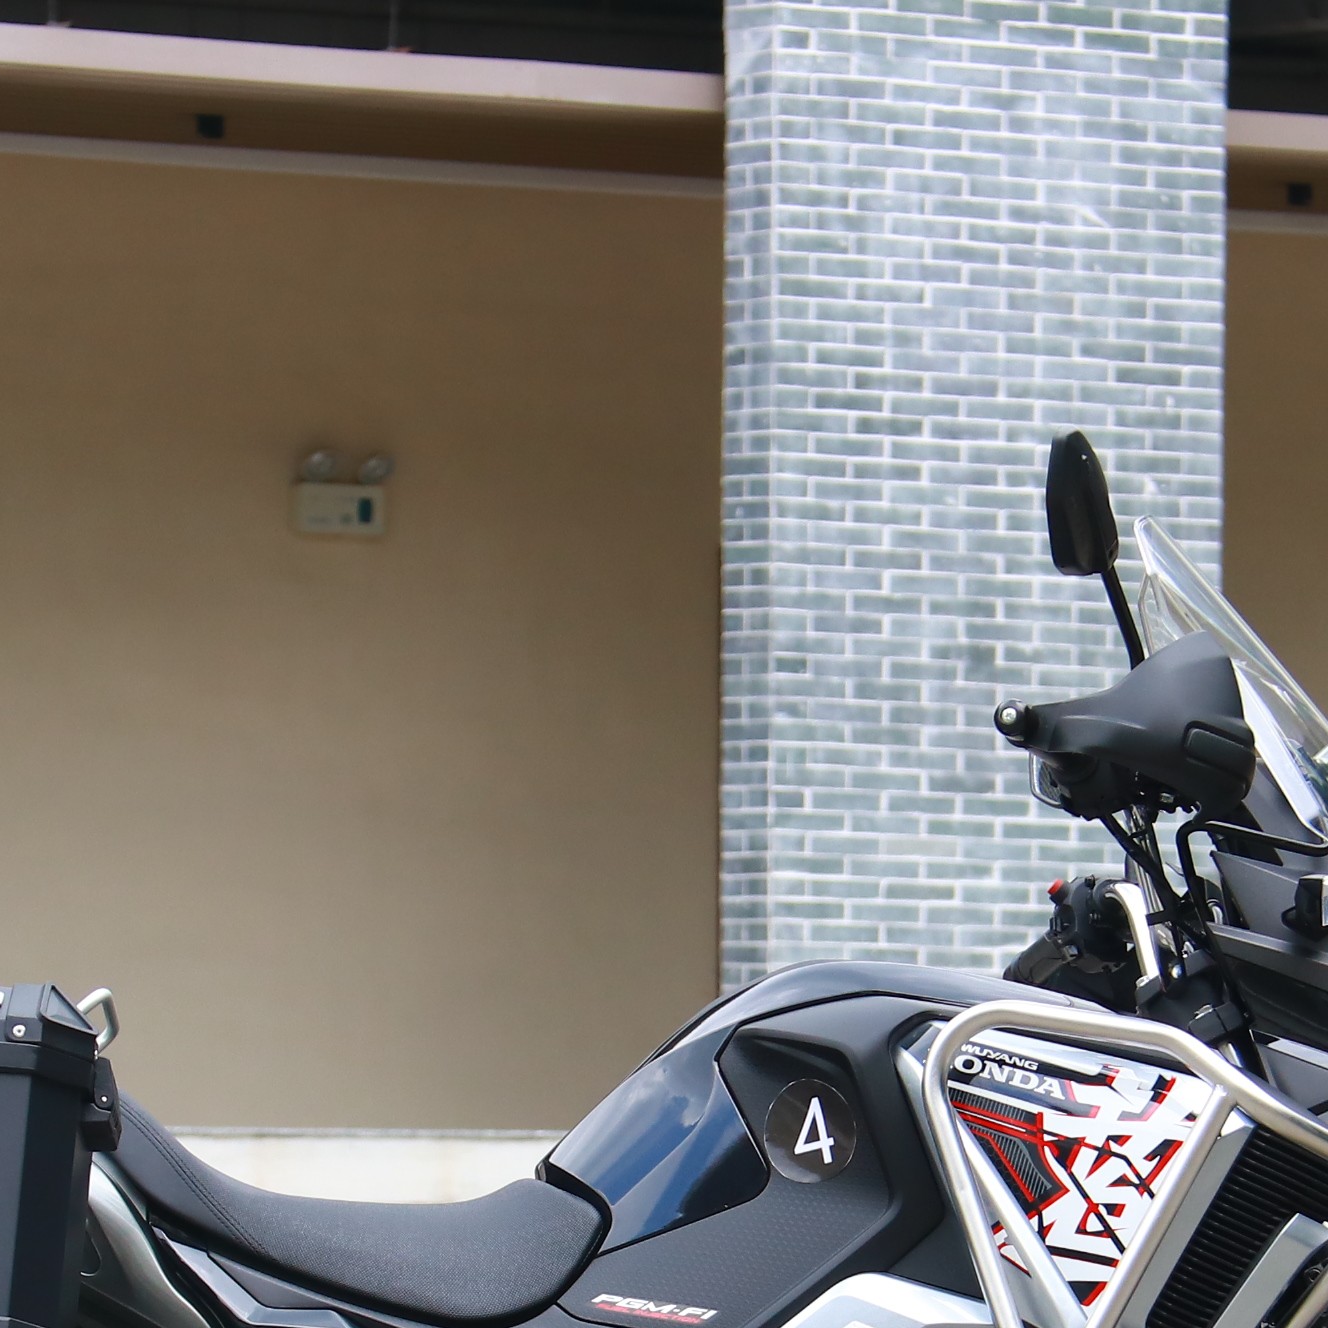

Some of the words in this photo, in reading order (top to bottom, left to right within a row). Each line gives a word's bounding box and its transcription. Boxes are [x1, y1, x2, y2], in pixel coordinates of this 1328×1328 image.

[949, 1054, 1066, 1100] ONDA
[960, 1043, 1039, 1071] WUYANG
[794, 1096, 835, 1165] 4
